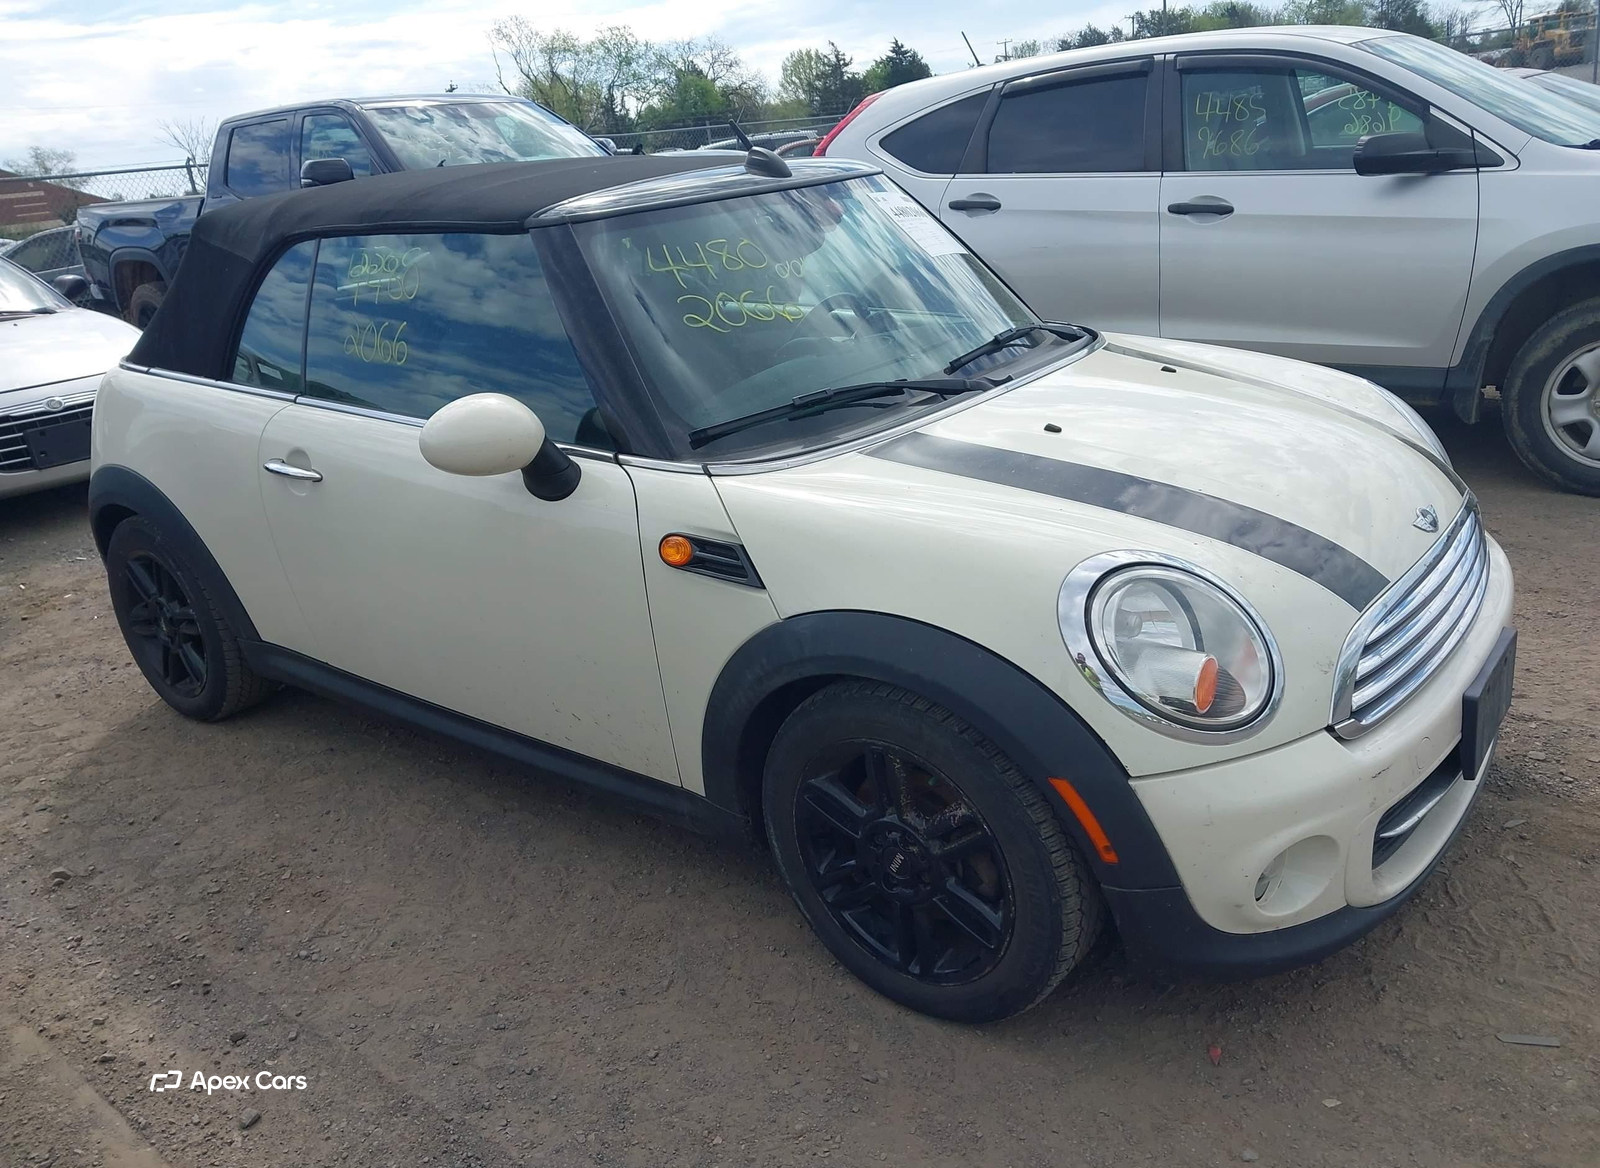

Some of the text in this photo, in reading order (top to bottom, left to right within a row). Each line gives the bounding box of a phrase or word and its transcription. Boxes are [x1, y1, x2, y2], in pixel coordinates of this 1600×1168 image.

[1196, 92, 1267, 123] 4485
[1198, 126, 1260, 159] 9686
[647, 237, 768, 290] 4480
[677, 285, 804, 333] 2066
[344, 313, 408, 366] 2066
[889, 852, 905, 873] MINI
